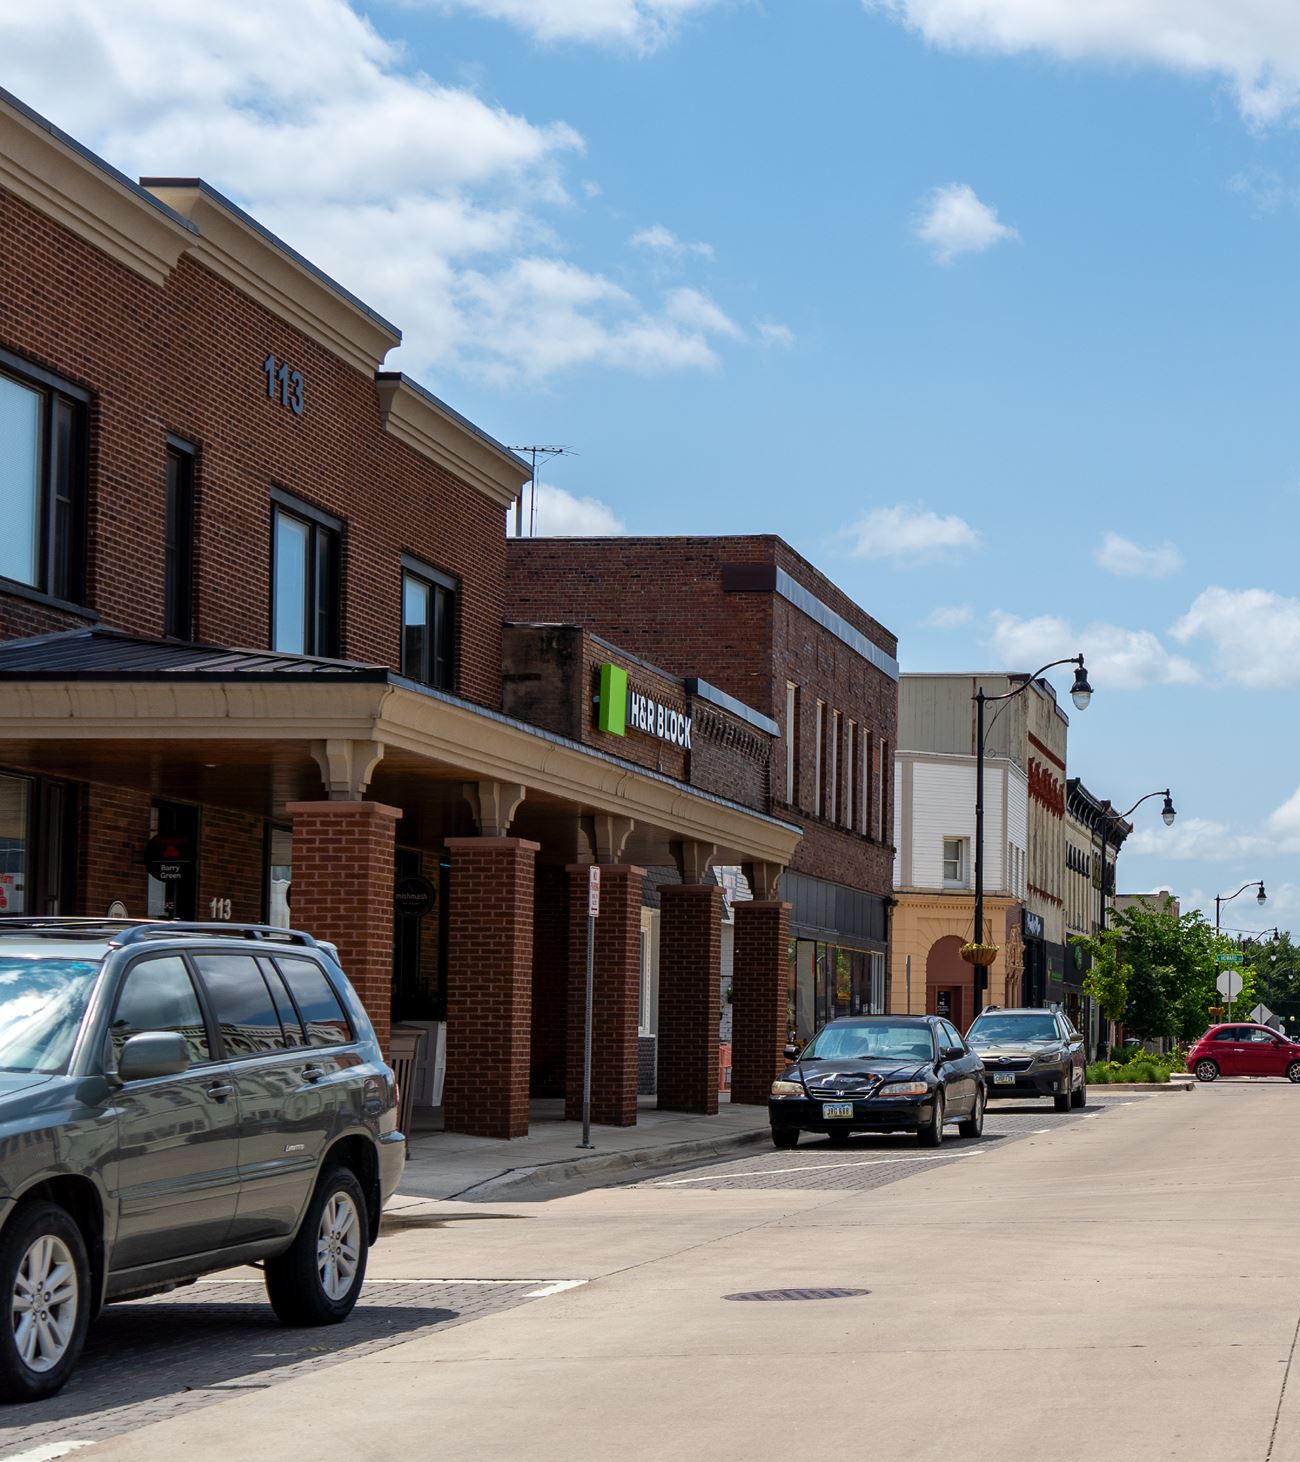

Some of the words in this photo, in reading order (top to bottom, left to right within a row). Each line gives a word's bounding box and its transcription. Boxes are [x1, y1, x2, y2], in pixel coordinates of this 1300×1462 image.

[264, 352, 304, 415] 113
[631, 691, 655, 734] H&R
[656, 703, 692, 749] BLOCK
[160, 864, 181, 872] Barry
[209, 897, 232, 920] 113
